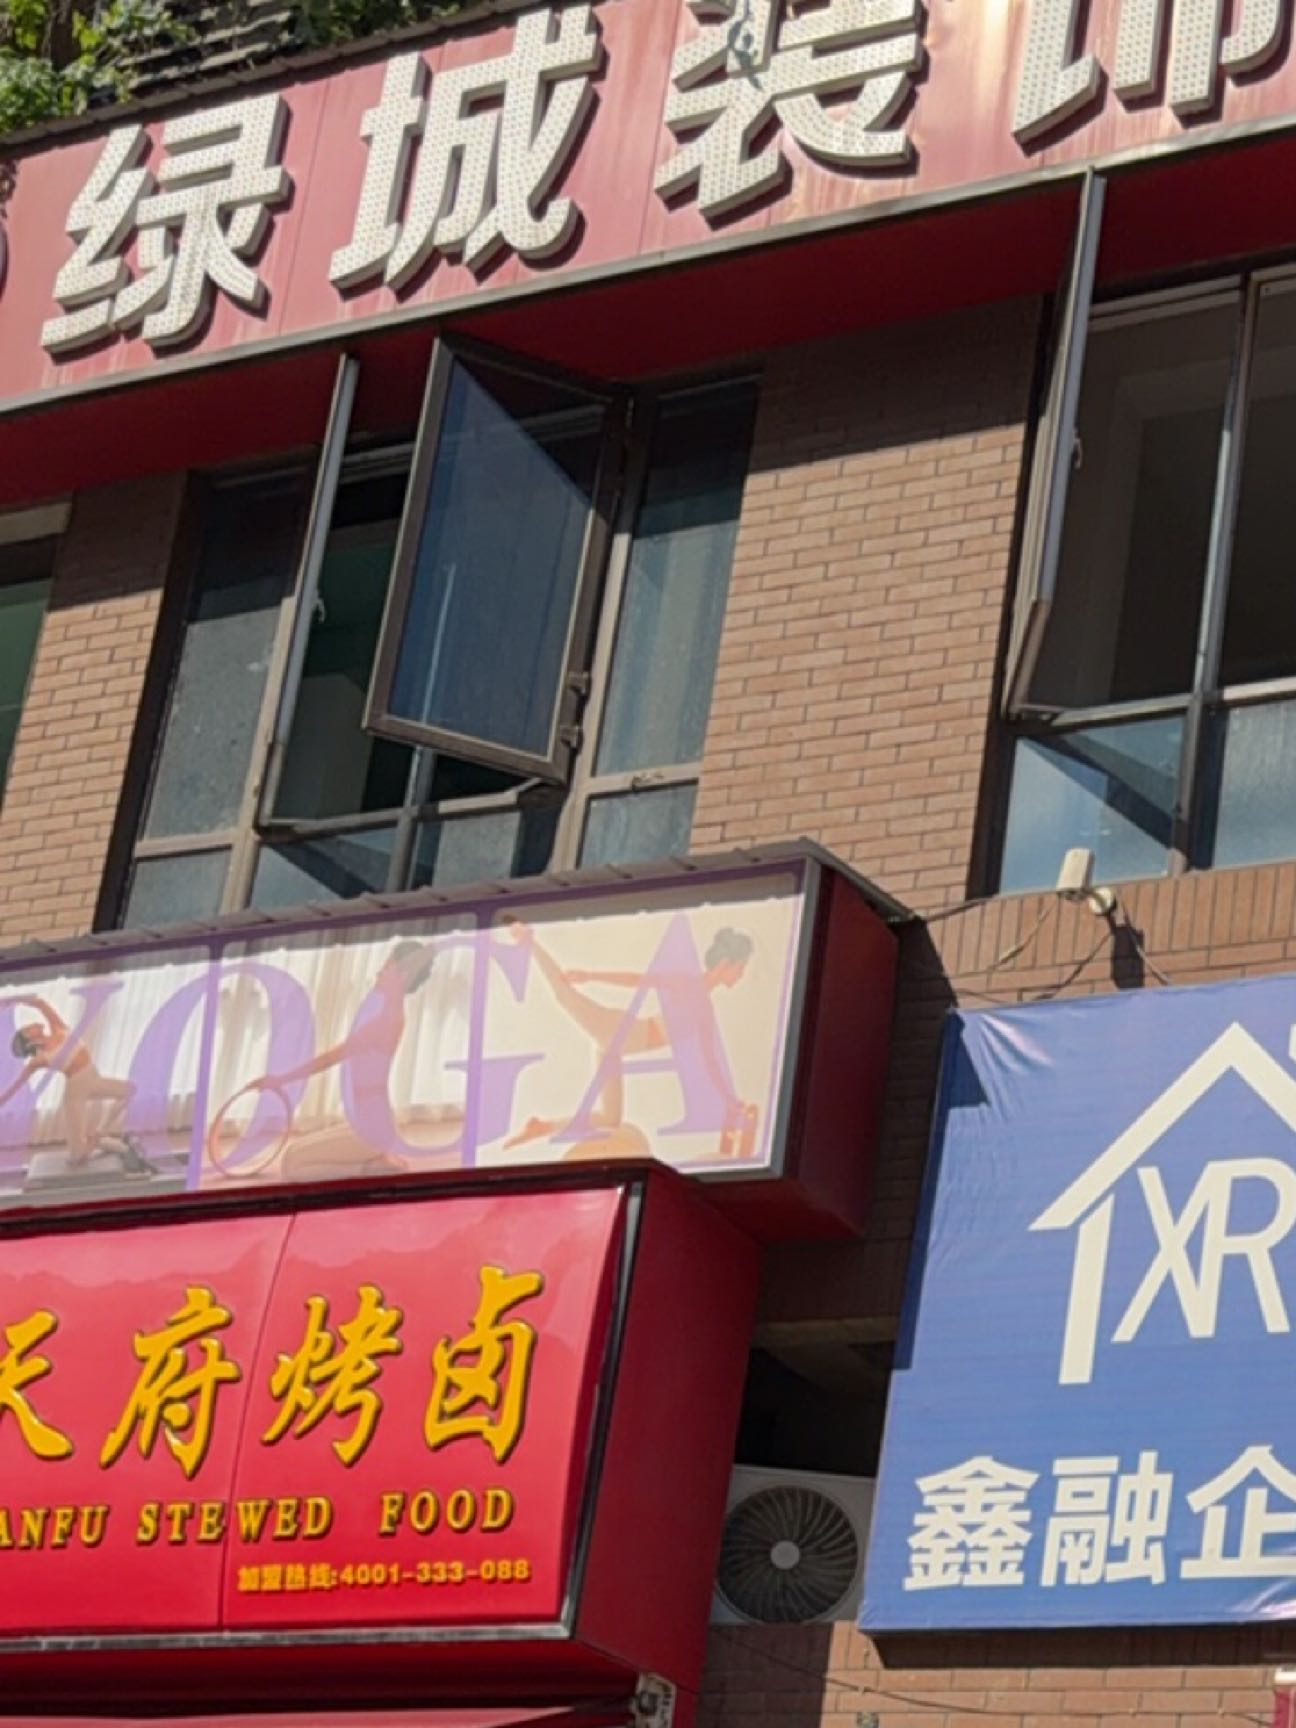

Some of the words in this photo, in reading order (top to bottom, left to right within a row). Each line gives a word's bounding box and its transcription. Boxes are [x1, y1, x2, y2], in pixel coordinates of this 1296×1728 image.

[0, 1265, 544, 1479] 天府烤卤
[136, 1495, 334, 1544] STEWED
[378, 1488, 516, 1536] FOOD
